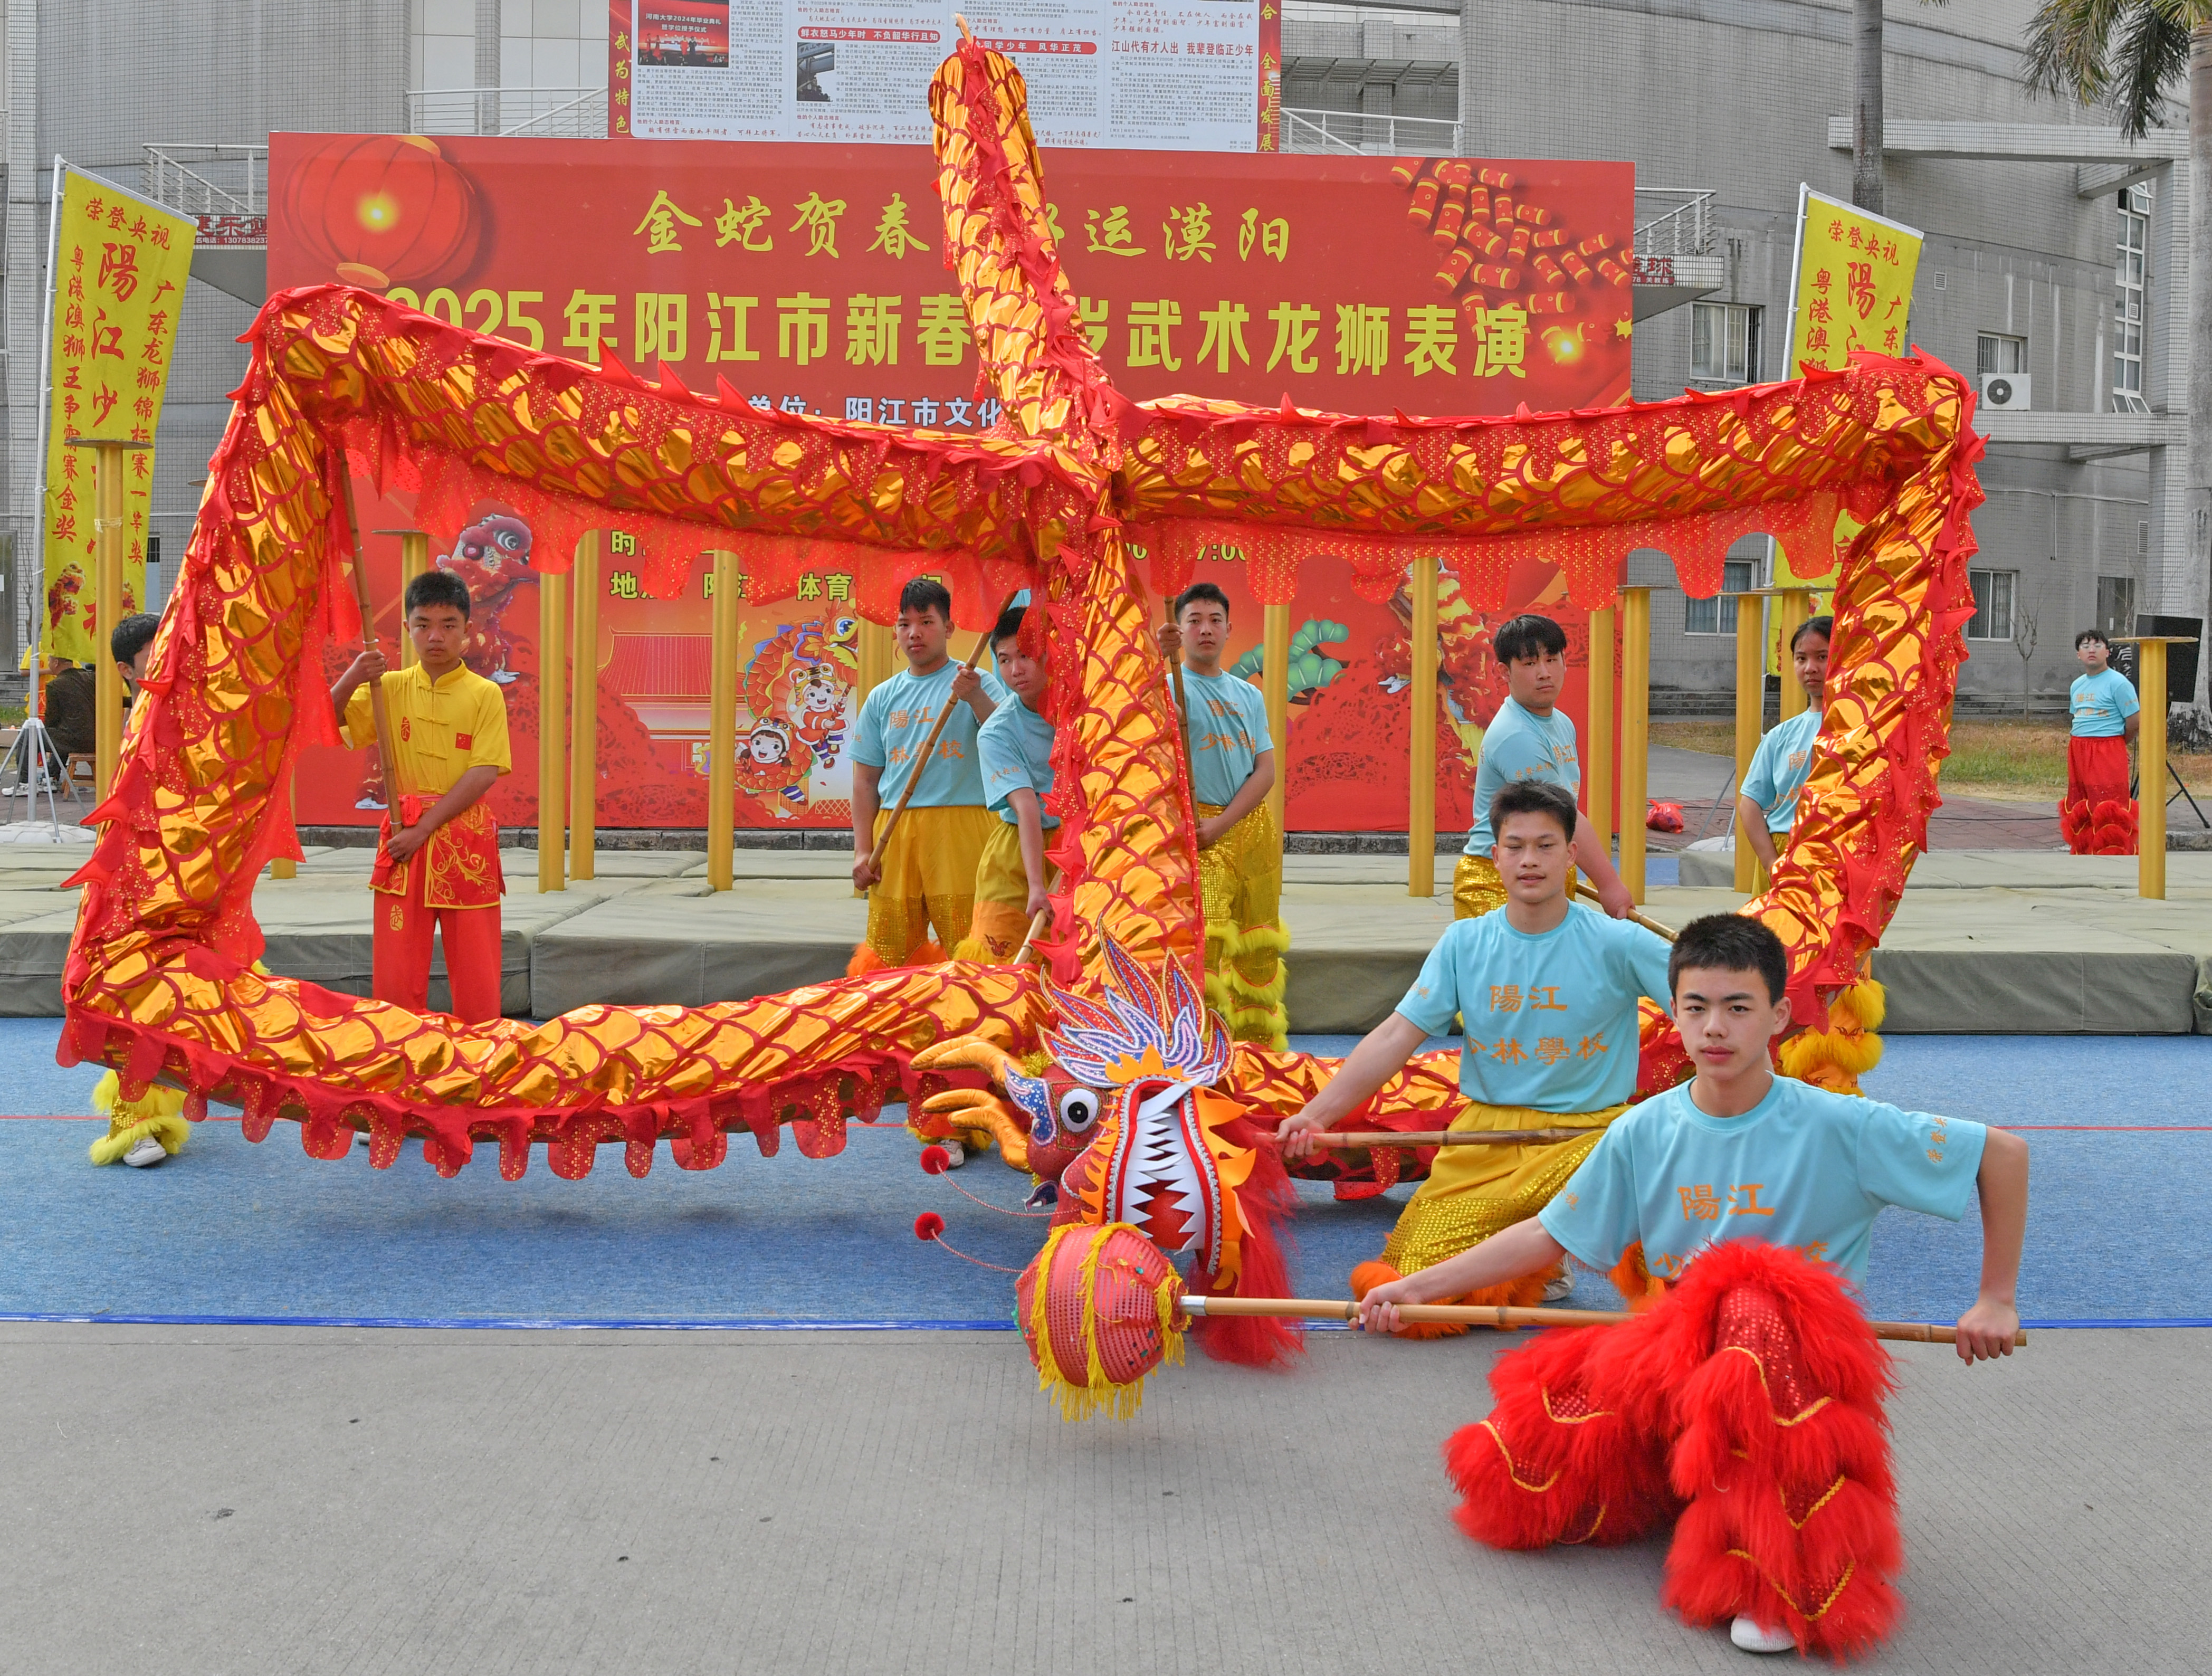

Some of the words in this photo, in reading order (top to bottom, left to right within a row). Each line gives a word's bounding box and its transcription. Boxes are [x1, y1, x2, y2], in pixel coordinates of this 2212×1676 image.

[645, 13, 721, 25] 河南大学2024年毕业典礼
[661, 24, 707, 33] 暨学位授予仪式
[800, 28, 866, 39] 鲜衣怒马少年时
[873, 30, 938, 41] 不负韶华行且知
[1038, 42, 1082, 53] 风华正茂
[1111, 40, 1178, 54] 江山代有才人出
[1187, 42, 1253, 57] 我辈登临正少年
[614, 31, 631, 135] 武为特色
[1258, 52, 1277, 152] 全面发展
[85, 197, 170, 251] 荣登央视
[633, 189, 931, 261] 金蛇贺春
[1828, 220, 1900, 266] 荣登央视
[889, 707, 935, 730] 陽江
[1490, 985, 1568, 1013] 陽江
[1677, 1184, 1776, 1221] 陽江
